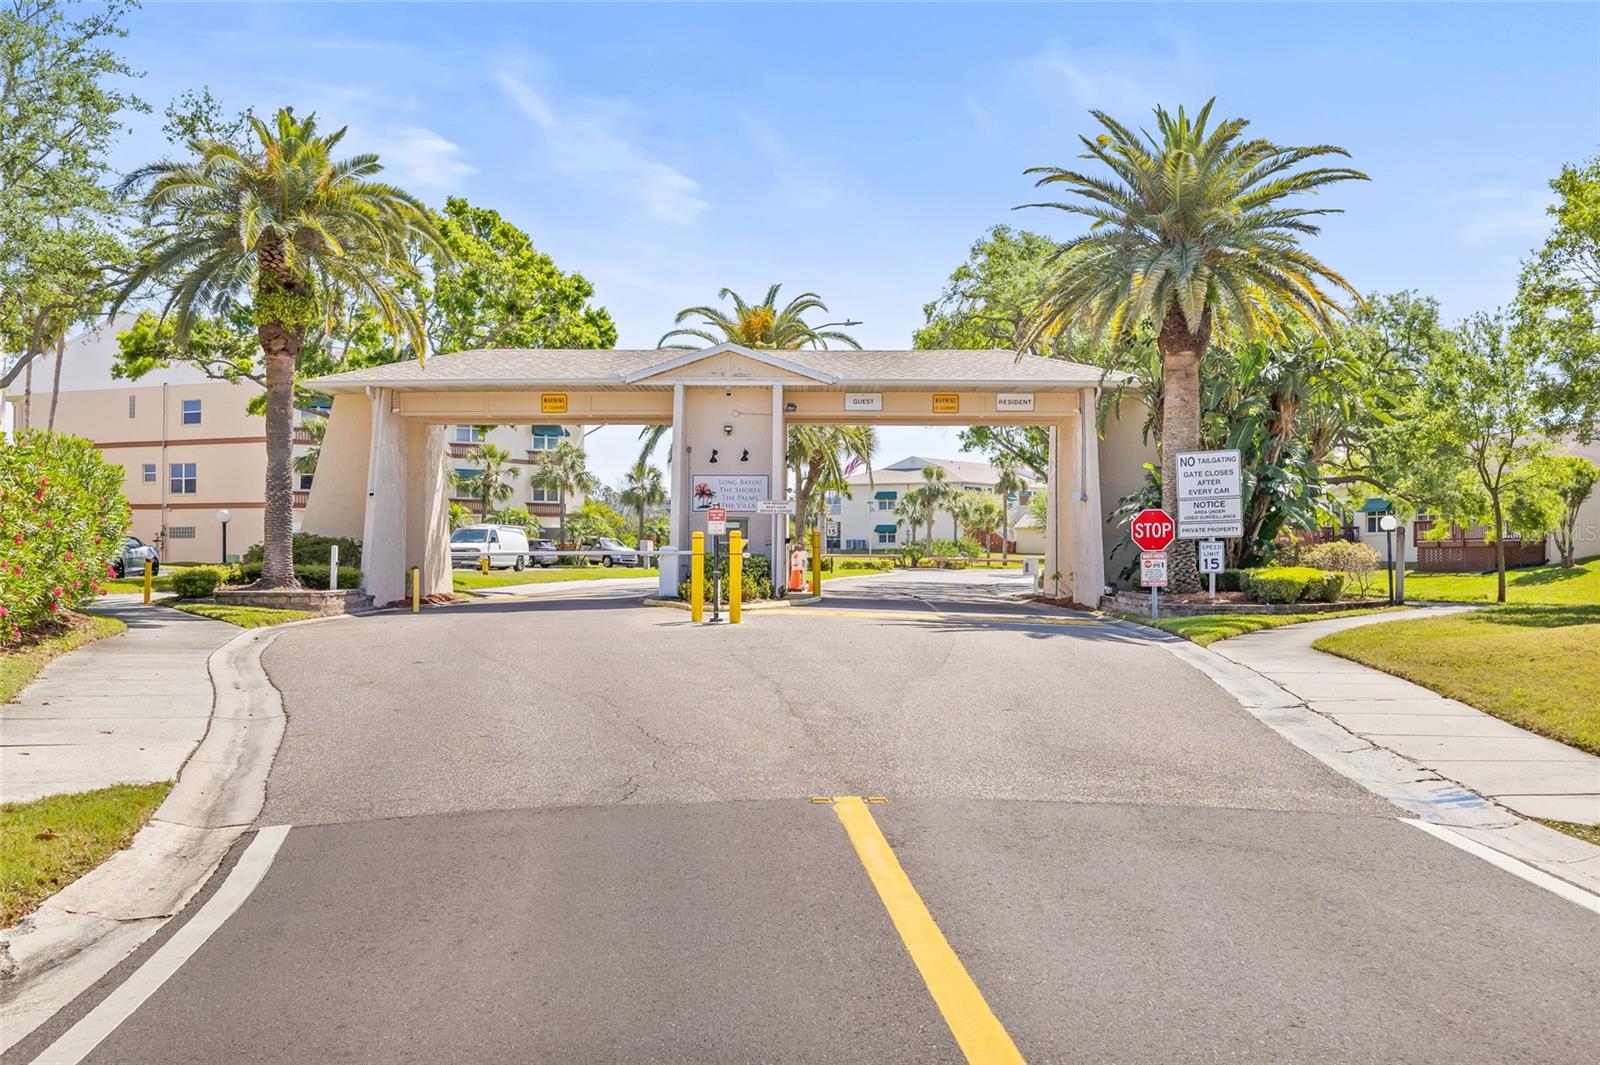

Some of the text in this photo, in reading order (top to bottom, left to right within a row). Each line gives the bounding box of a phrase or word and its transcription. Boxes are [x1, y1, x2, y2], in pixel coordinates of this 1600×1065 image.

[1180, 455, 1237, 467] NO TAILGATING
[1183, 469, 1234, 478] GATE CLOSES
[1188, 487, 1230, 496] EVERY CAR
[1193, 500, 1226, 509] NOTICE
[1134, 522, 1172, 538] STOP
[1203, 558, 1220, 570] 15
